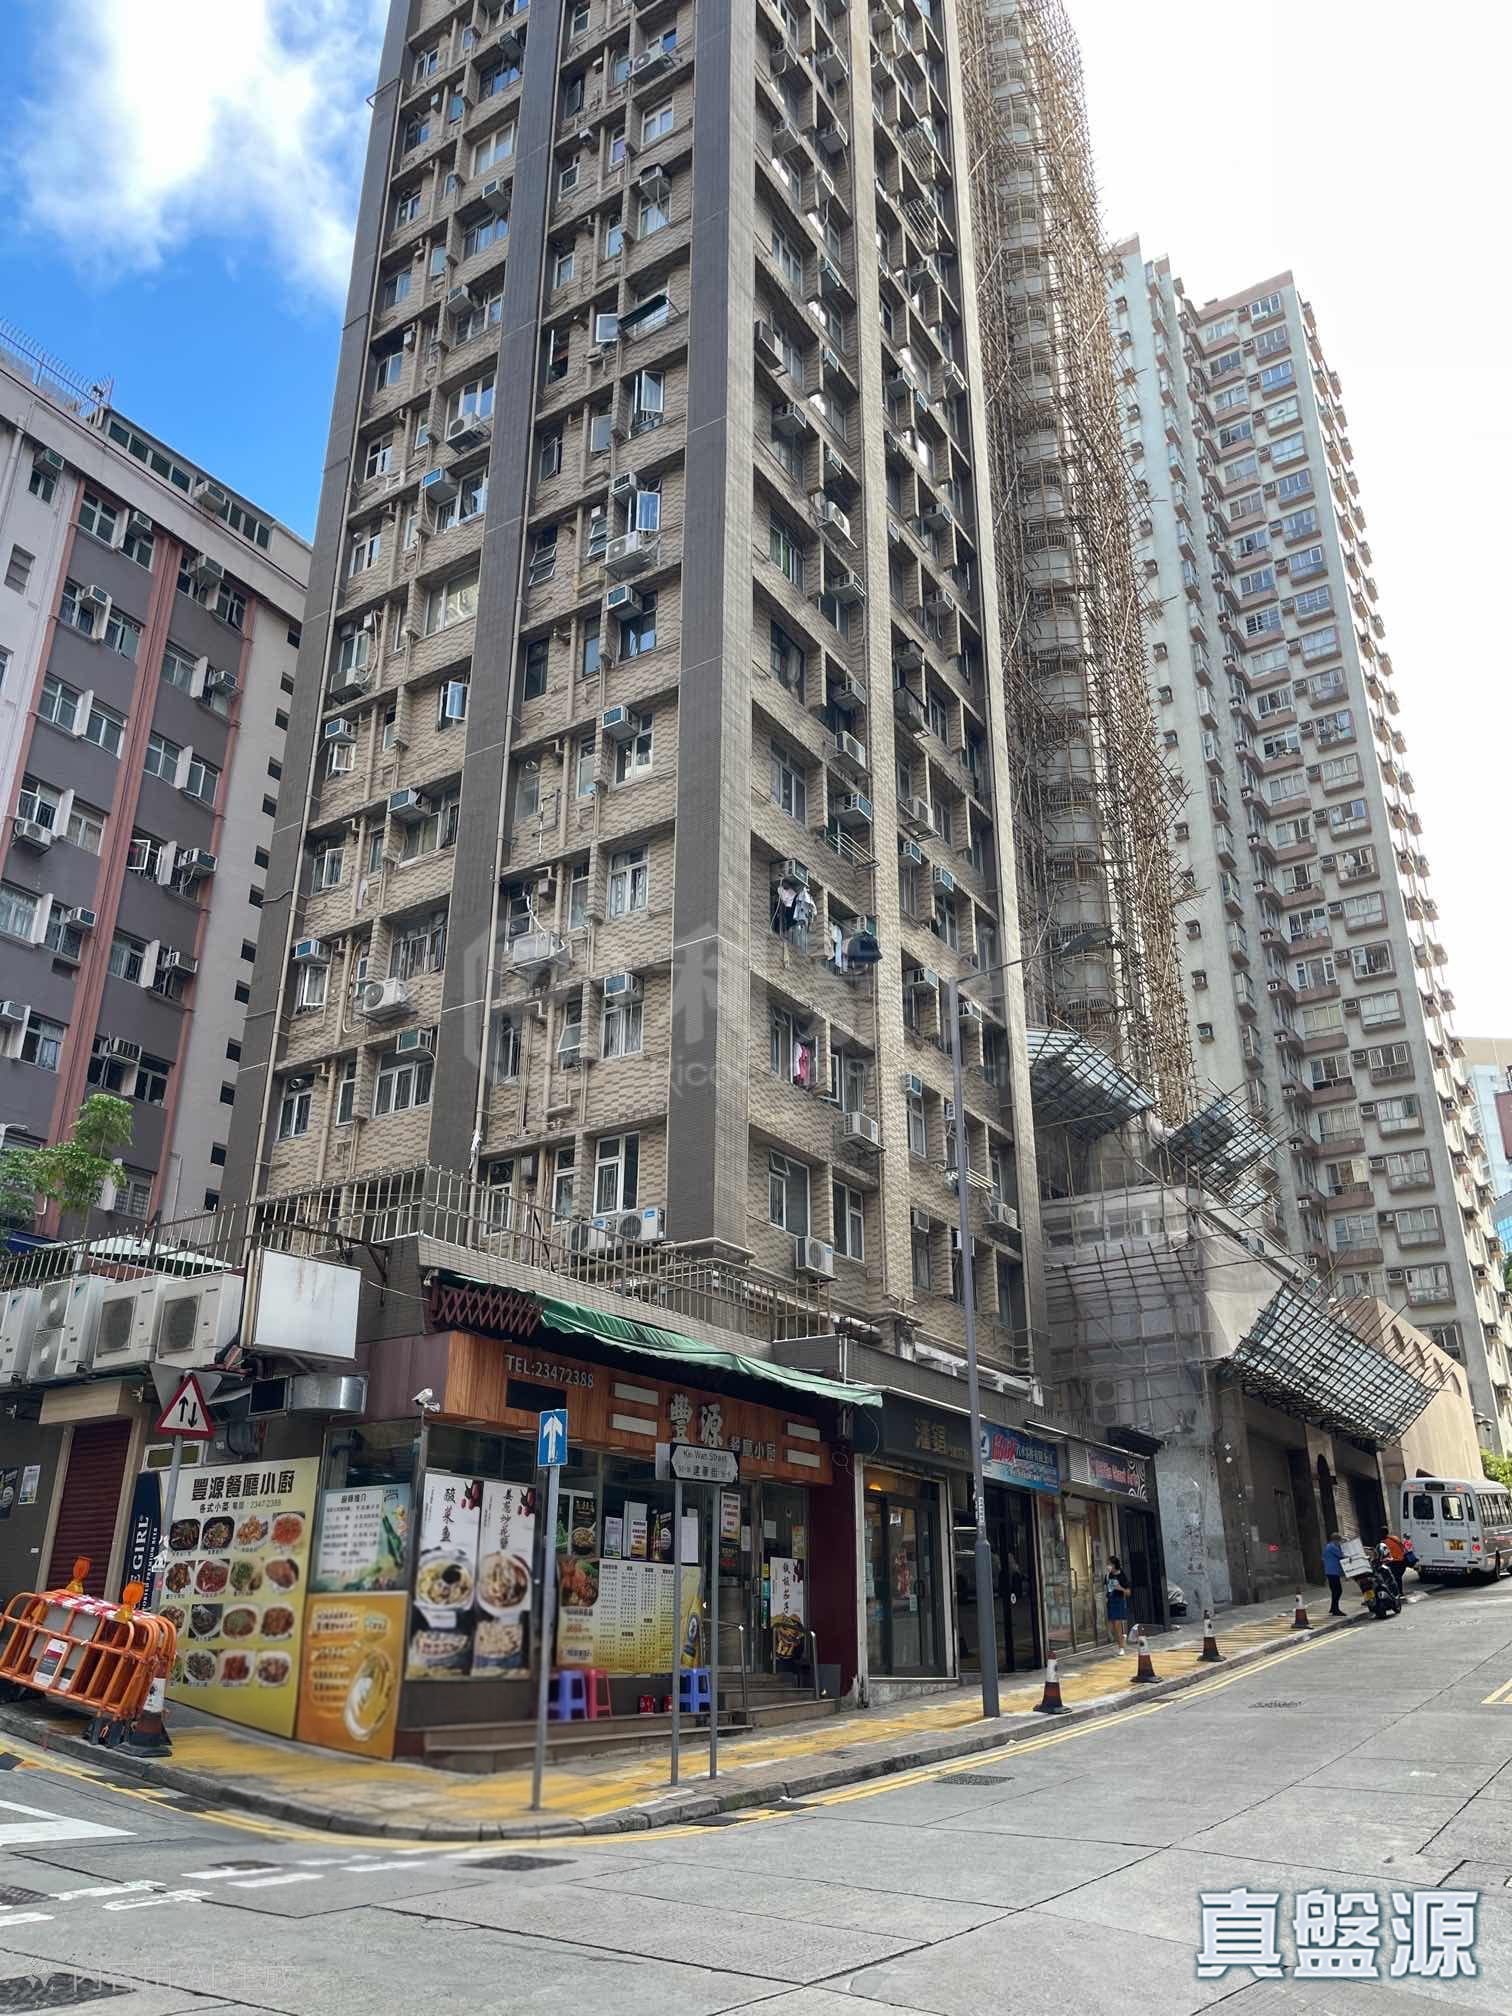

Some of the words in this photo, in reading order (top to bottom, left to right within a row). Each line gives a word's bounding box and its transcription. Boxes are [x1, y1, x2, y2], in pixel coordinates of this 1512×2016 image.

[504, 1354, 594, 1389] TEL:23472388
[191, 1470, 295, 1501] 豐源餐廳小廚
[200, 1501, 230, 1514] 各式小菜
[132, 1516, 150, 1570] GIRL
